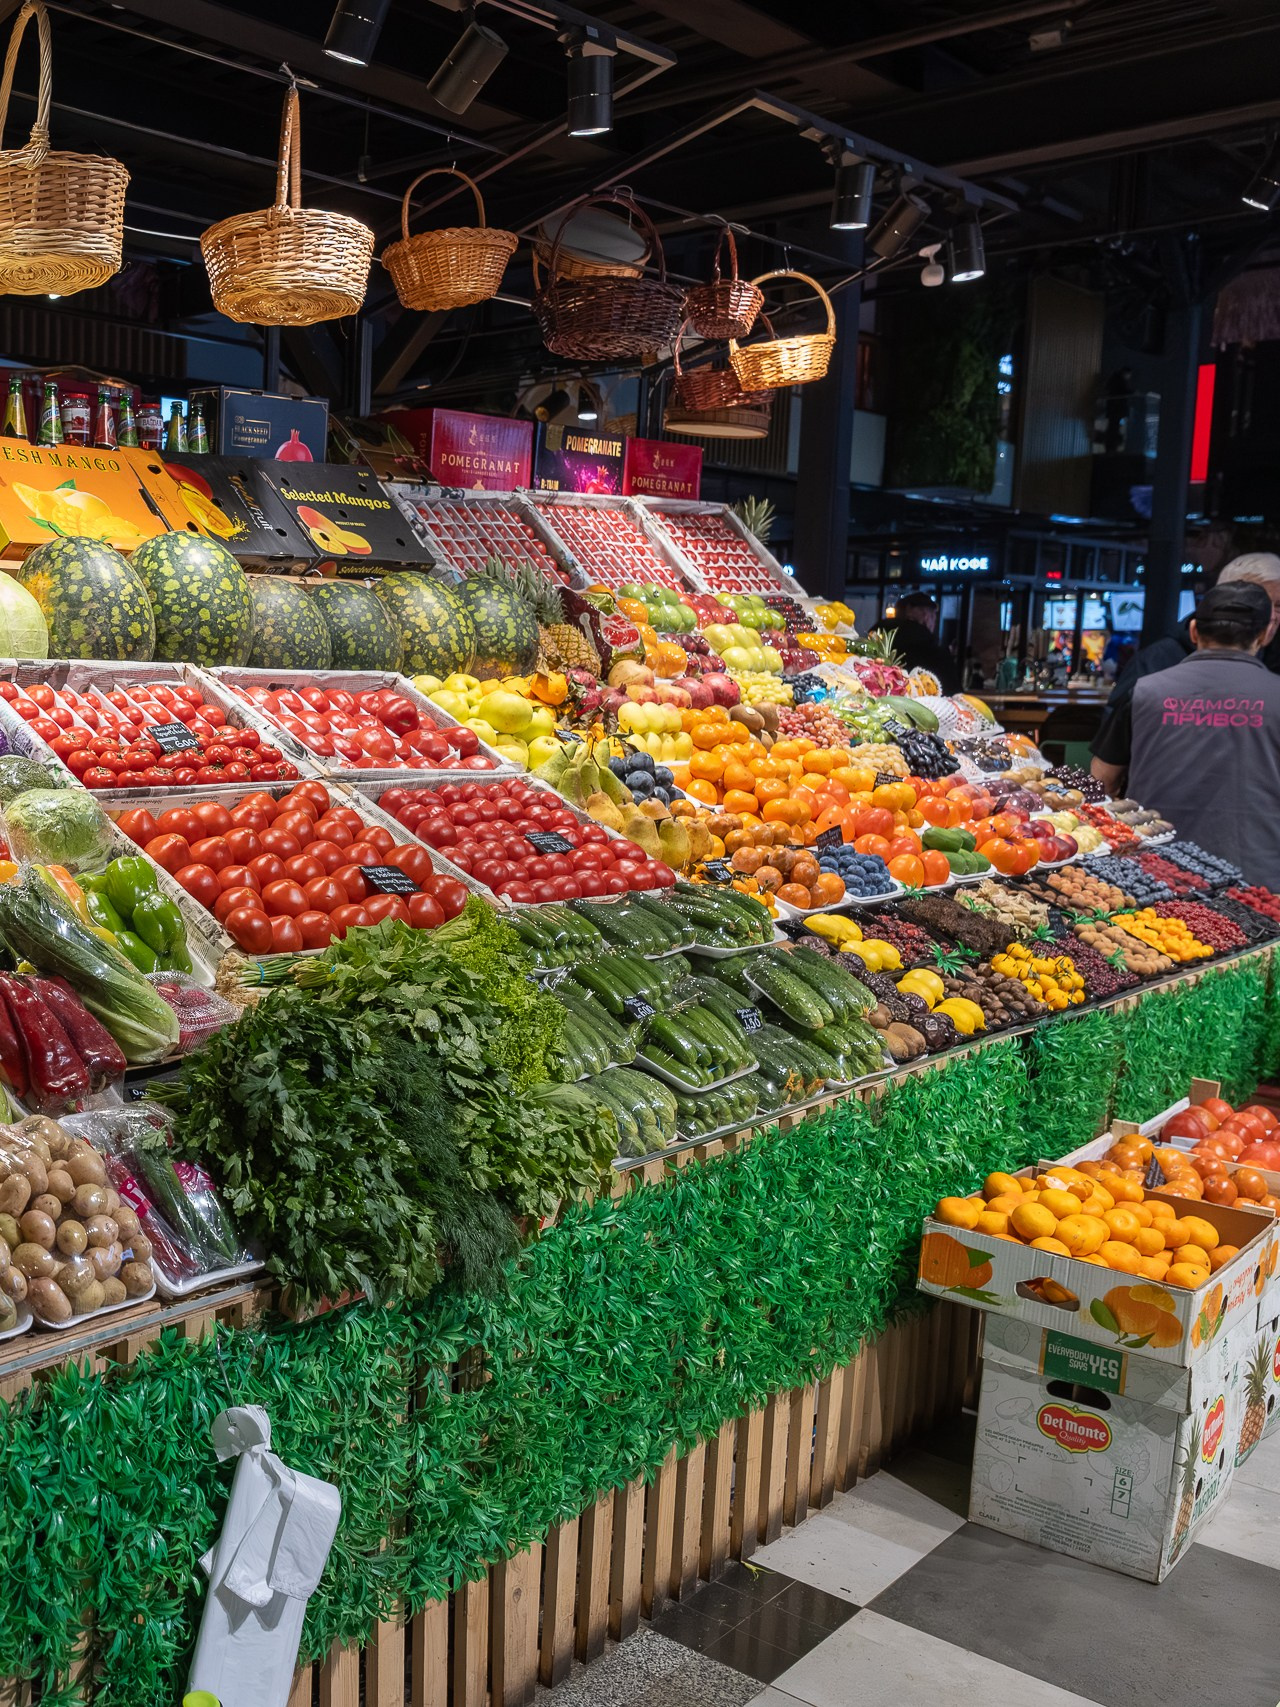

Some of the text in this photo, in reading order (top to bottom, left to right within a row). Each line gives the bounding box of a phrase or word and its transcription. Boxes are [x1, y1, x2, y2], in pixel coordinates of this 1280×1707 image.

[566, 435, 622, 457] POMEGRANATE
[48, 451, 120, 472] MANGO
[441, 453, 520, 474] POMEGRANAT
[631, 476, 692, 494] POMEGRANAT
[280, 487, 334, 504] Selected
[333, 491, 391, 511] Mangos
[921, 555, 989, 571] ЧАЙ КОФЕ
[1162, 712, 1263, 728] ПРИВОЗ
[1048, 1343, 1090, 1363] EVERYBODY
[1068, 1358, 1088, 1372] SAYS
[1089, 1354, 1119, 1380] YES
[1043, 1413, 1107, 1442] Del Monte
[1115, 1466, 1135, 1478] SIZE:
[1119, 1478, 1127, 1486] 6
[1118, 1490, 1126, 1499] 7
[979, 1511, 996, 1521] CLASS
